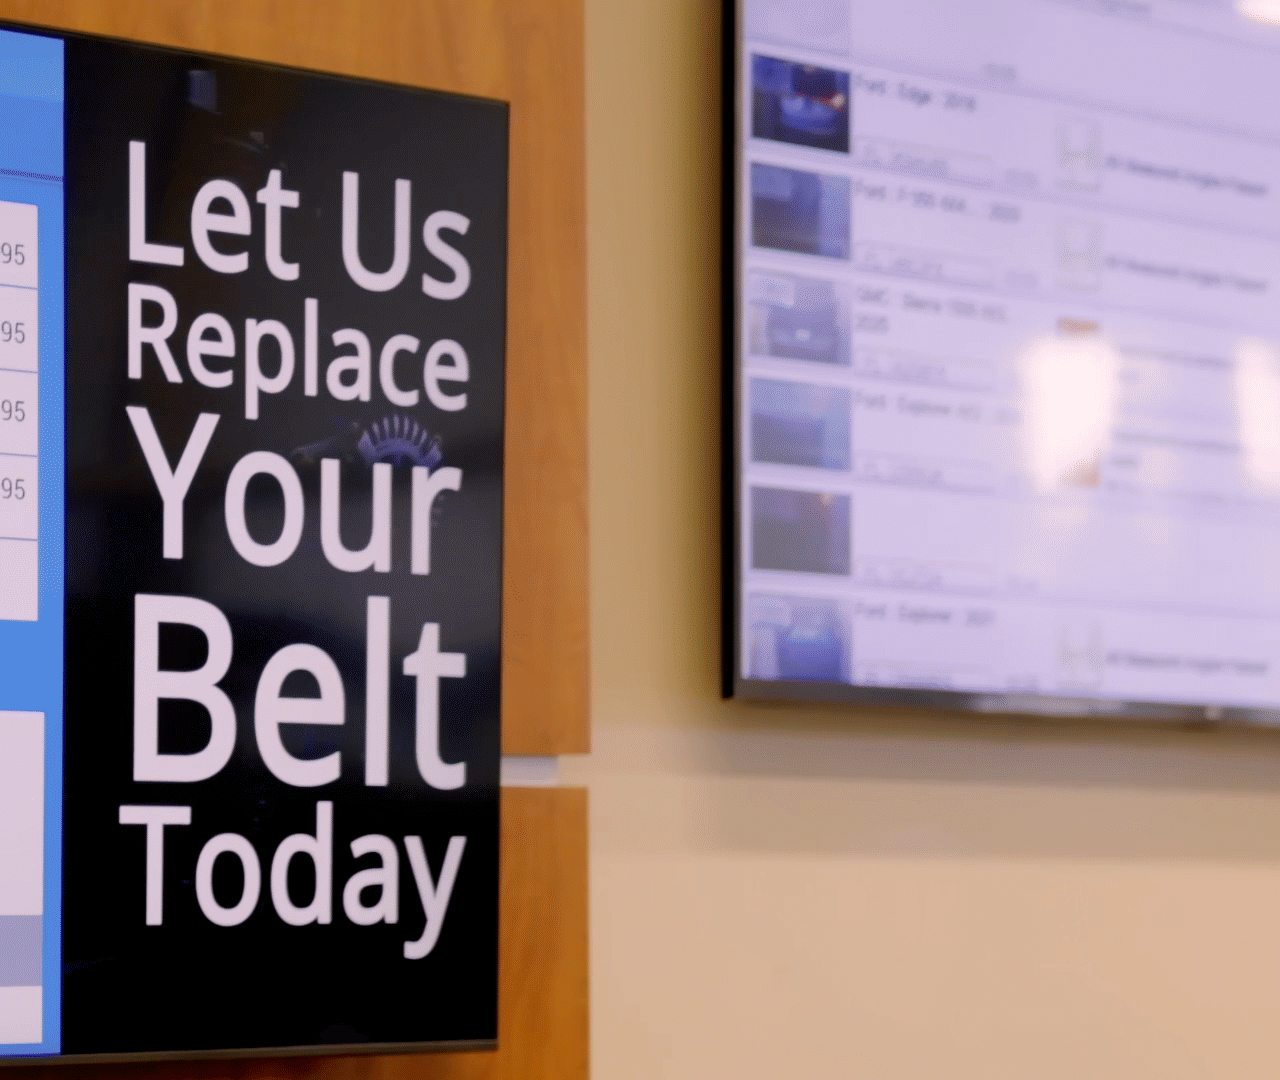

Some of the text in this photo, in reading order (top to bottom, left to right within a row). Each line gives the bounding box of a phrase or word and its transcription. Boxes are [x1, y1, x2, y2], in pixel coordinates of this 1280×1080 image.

[0, 243, 26, 265] 95
[128, 140, 471, 300] Let Us
[0, 320, 26, 344] 95
[127, 282, 470, 421] Replace
[0, 399, 26, 422] 95
[0, 476, 26, 500] 95
[125, 405, 463, 576] Your
[133, 593, 468, 790] Belt
[118, 800, 468, 960] Today
